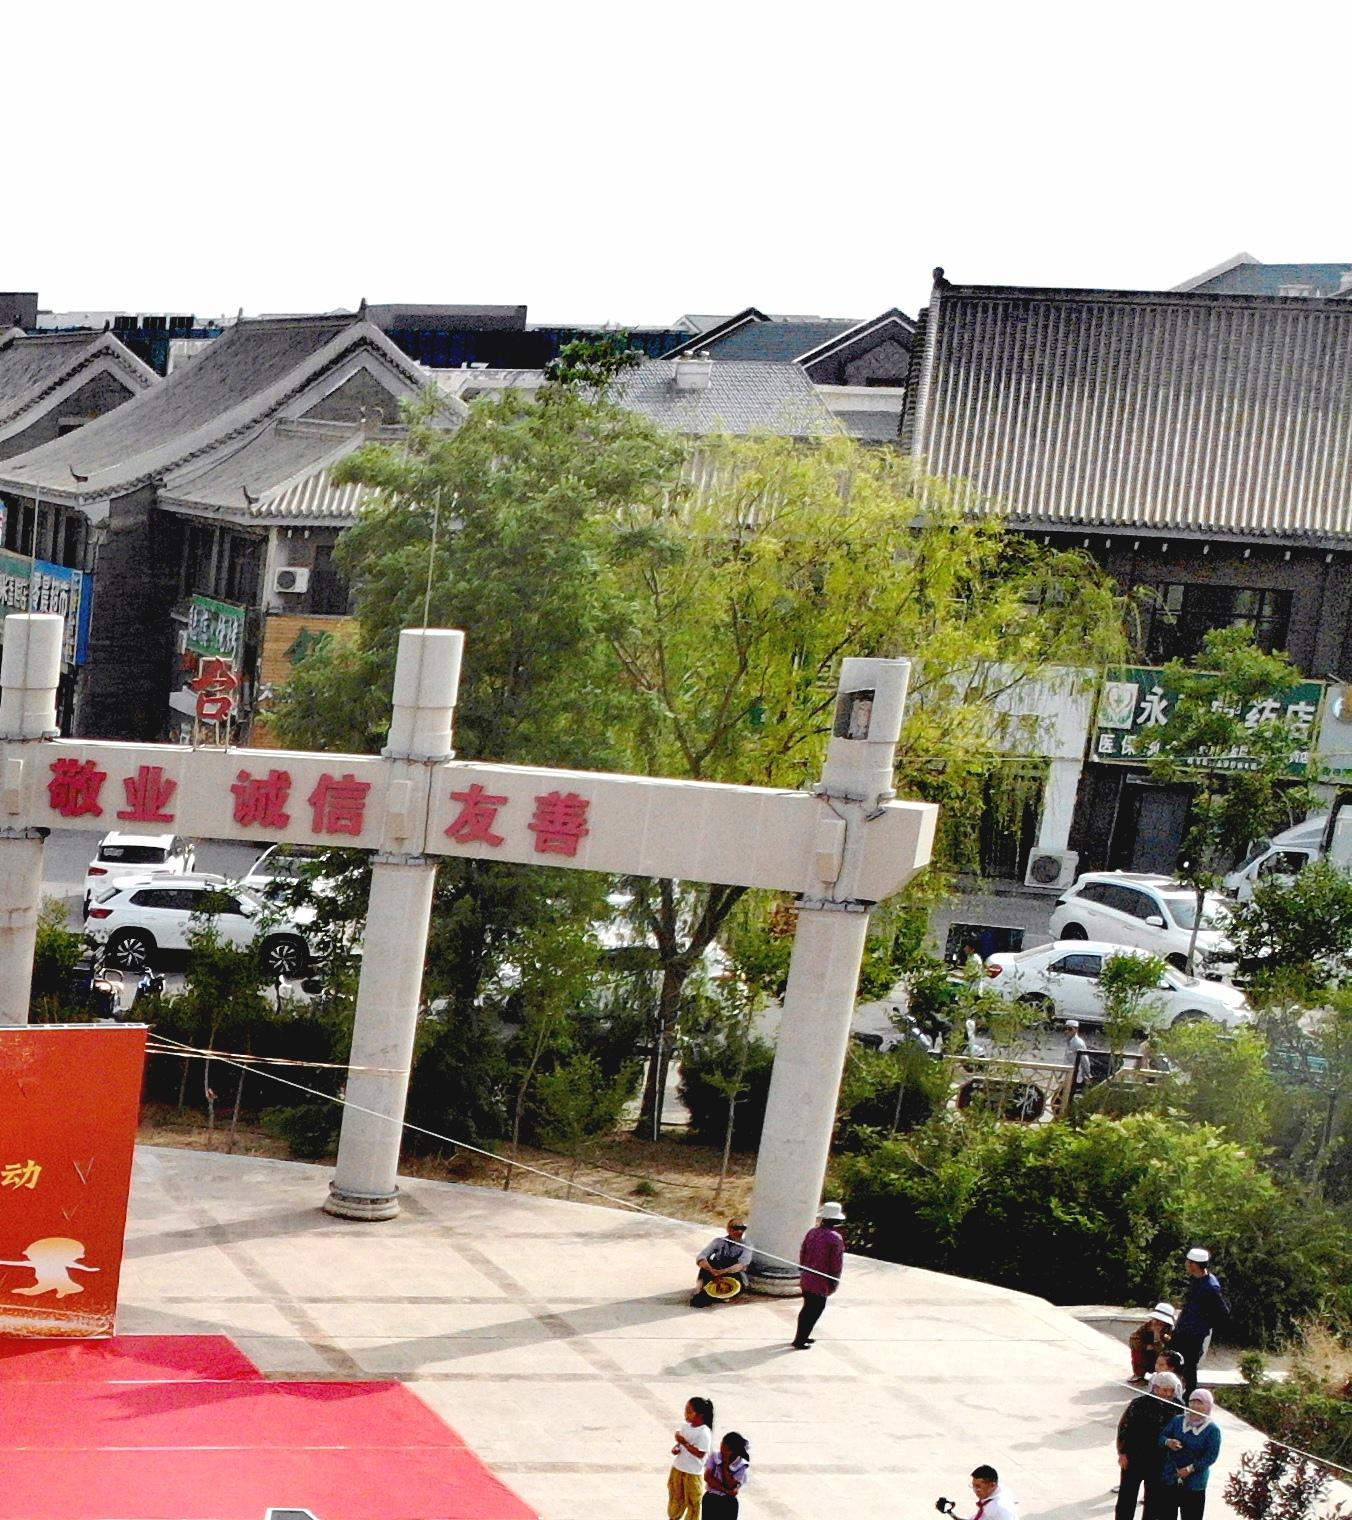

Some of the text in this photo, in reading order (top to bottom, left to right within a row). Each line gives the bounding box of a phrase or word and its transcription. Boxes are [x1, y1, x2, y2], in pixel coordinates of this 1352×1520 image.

[48, 759, 176, 822] 敬业
[231, 771, 369, 835] 诚信
[448, 786, 586, 855] 友善
